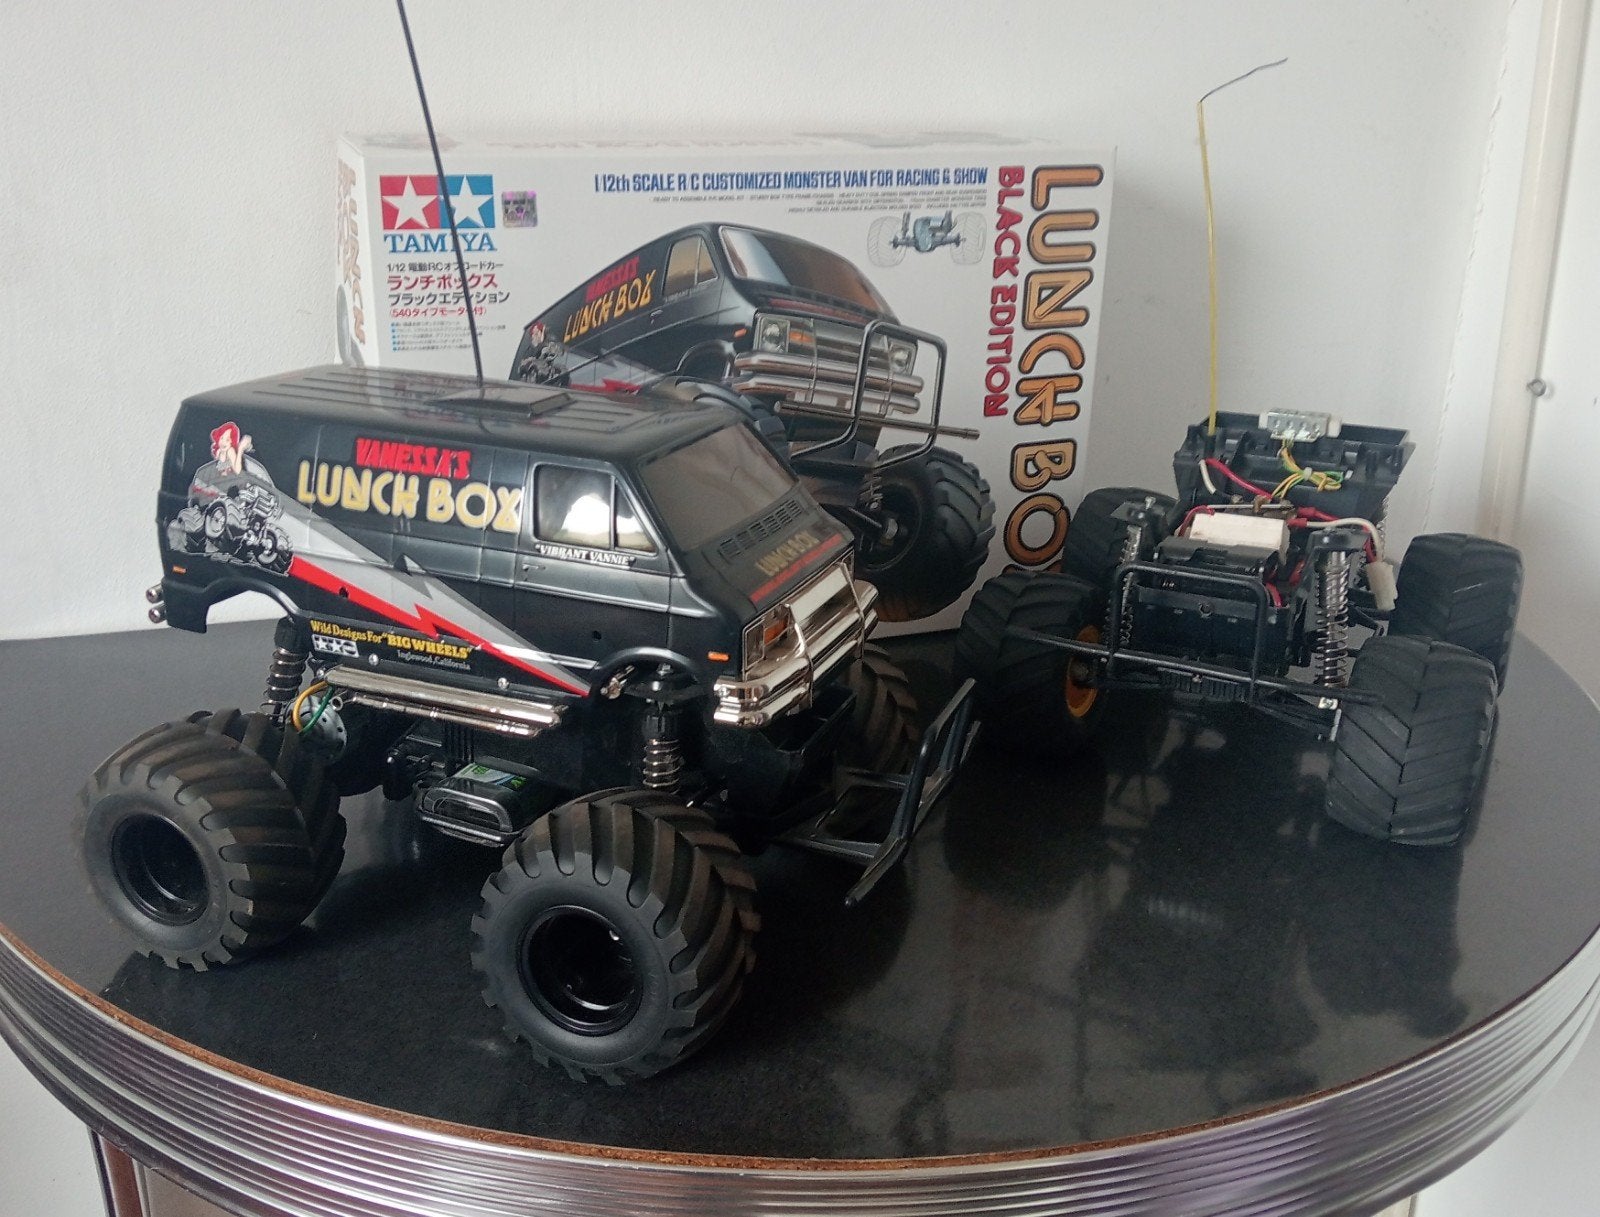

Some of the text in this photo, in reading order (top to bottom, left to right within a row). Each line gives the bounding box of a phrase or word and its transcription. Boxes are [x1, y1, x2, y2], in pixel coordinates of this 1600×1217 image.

[633, 173, 675, 191] SCALE
[703, 171, 782, 190] CUSTOMIZED
[784, 170, 841, 189] MONSTER
[844, 169, 867, 188] VAN
[869, 169, 893, 187] FOR
[896, 168, 939, 187] RACING
[954, 167, 988, 184] SHOW
[387, 263, 406, 272] 1/12
[387, 273, 498, 291] ランチボックス
[563, 290, 614, 344] LUNCH
[613, 269, 656, 319] BOX
[983, 165, 1025, 417] BLACK EDITION
[1003, 164, 1104, 567] LUNCH BO
[356, 437, 471, 480] VANESSA'S
[297, 459, 525, 533] LUNCH BOX
[310, 619, 332, 635] Wild
[332, 624, 367, 641] Designs
[366, 629, 382, 644] For
